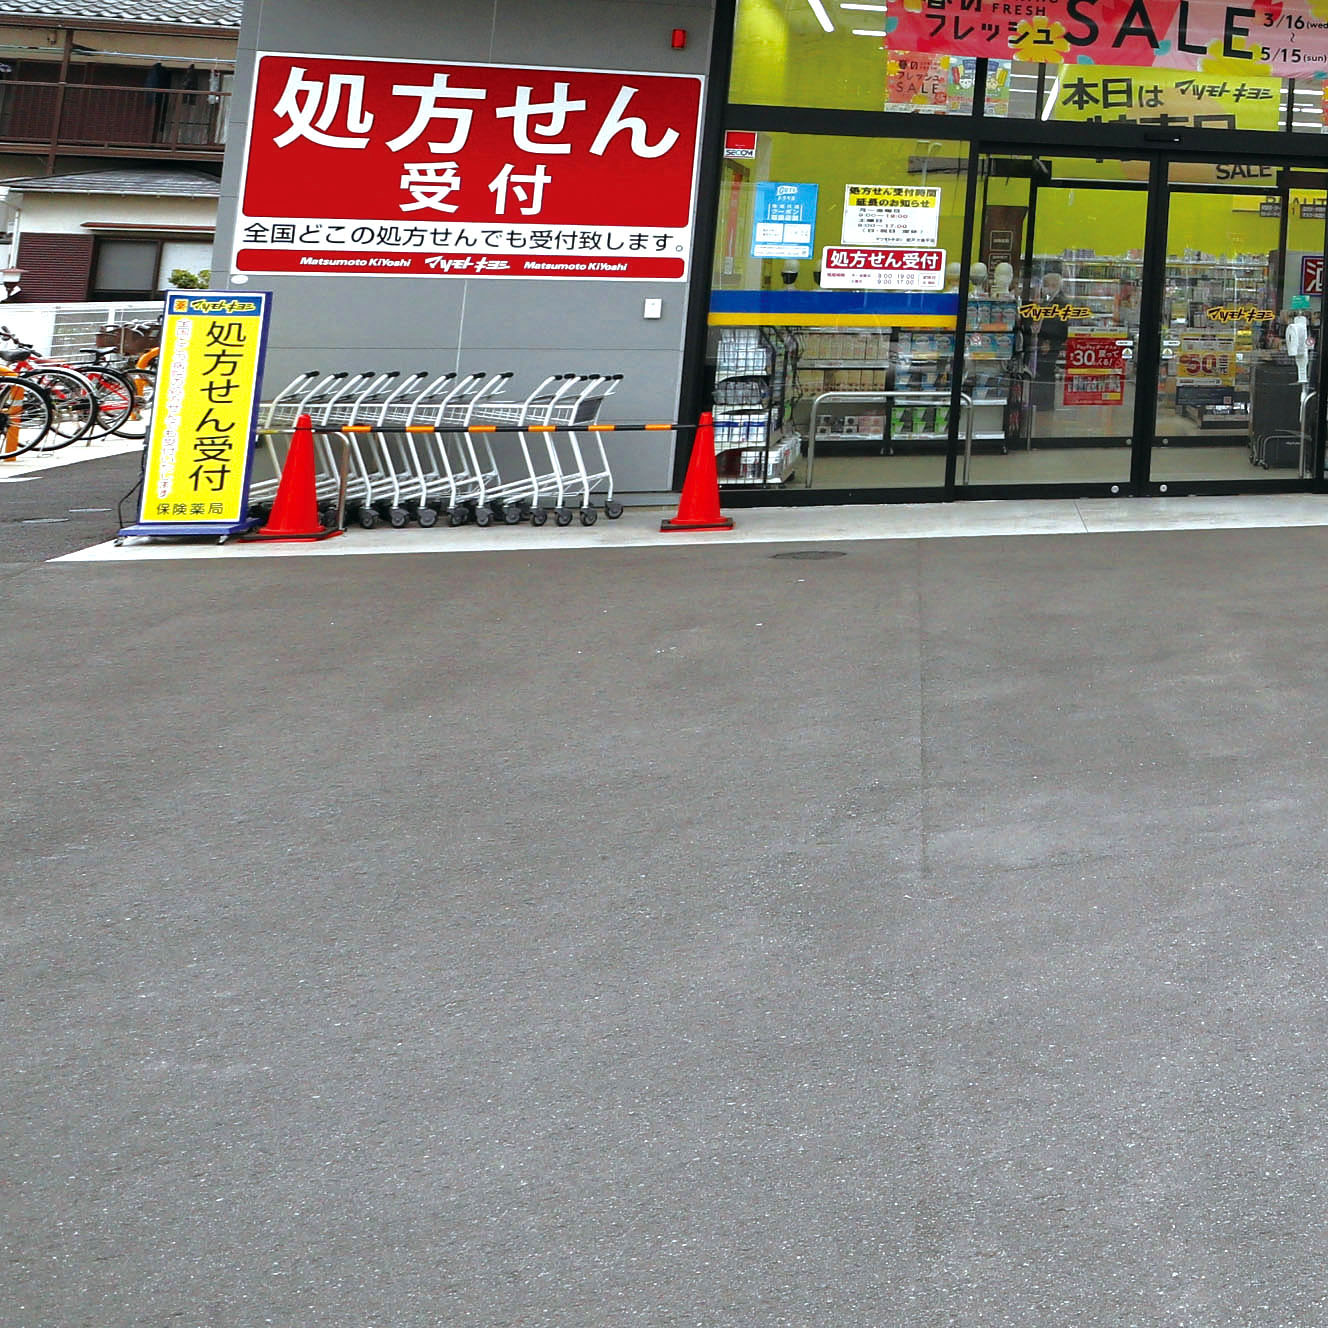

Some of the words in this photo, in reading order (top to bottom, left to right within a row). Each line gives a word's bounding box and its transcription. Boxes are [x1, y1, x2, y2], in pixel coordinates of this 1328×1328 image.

[992, 3, 1047, 17] FRESH
[925, 13, 1054, 45] フレッシュ
[1062, 77, 1164, 111] 本日は
[272, 66, 681, 159] 処方せん
[726, 149, 754, 157] SECOM
[398, 161, 552, 216] 受付
[243, 221, 684, 254] 全国どこの処方せんでも受付致します。
[299, 256, 367, 267] Matsumoto
[523, 260, 587, 271] Matsumoto
[830, 250, 939, 270] 処方せん受付
[189, 320, 247, 492] 処方せん受付
[157, 503, 224, 516] 保険薬局
